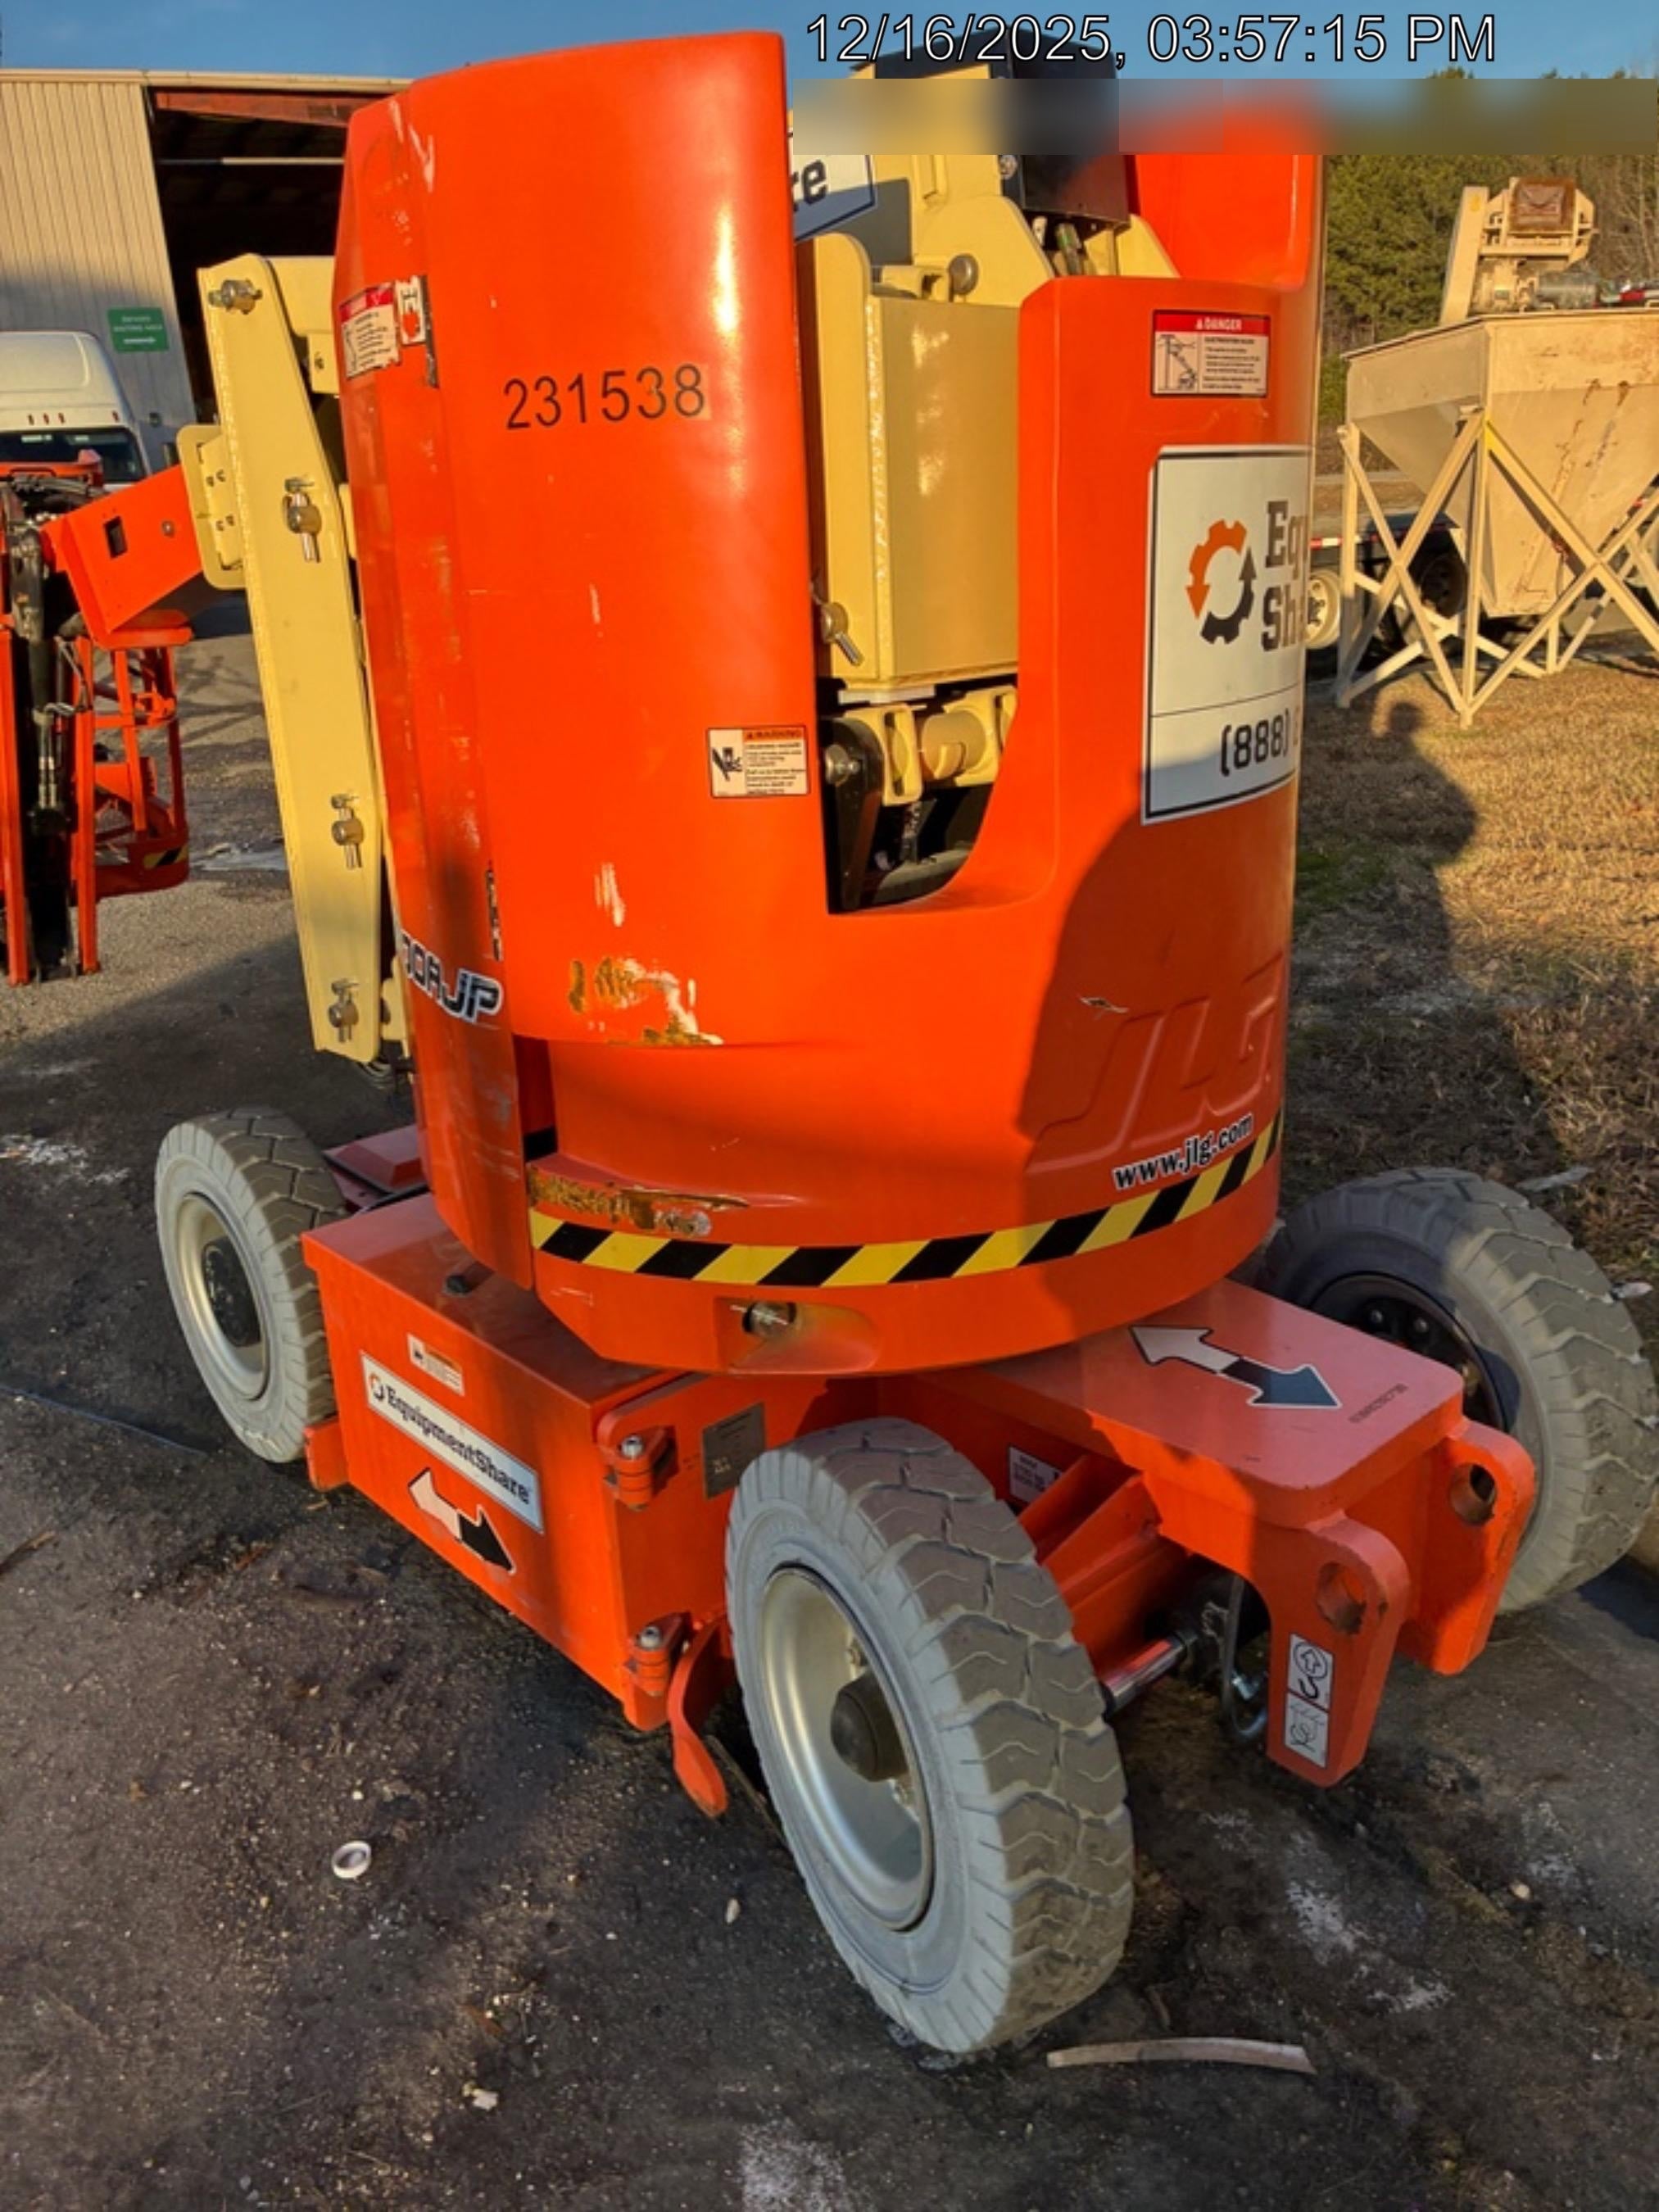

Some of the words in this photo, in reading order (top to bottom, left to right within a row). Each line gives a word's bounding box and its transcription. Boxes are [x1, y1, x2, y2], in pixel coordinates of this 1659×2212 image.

[503, 363, 705, 430] 231538
[1112, 1112, 1254, 1191] www.jlg.com
[386, 1384, 531, 1506] EquipmentShare
